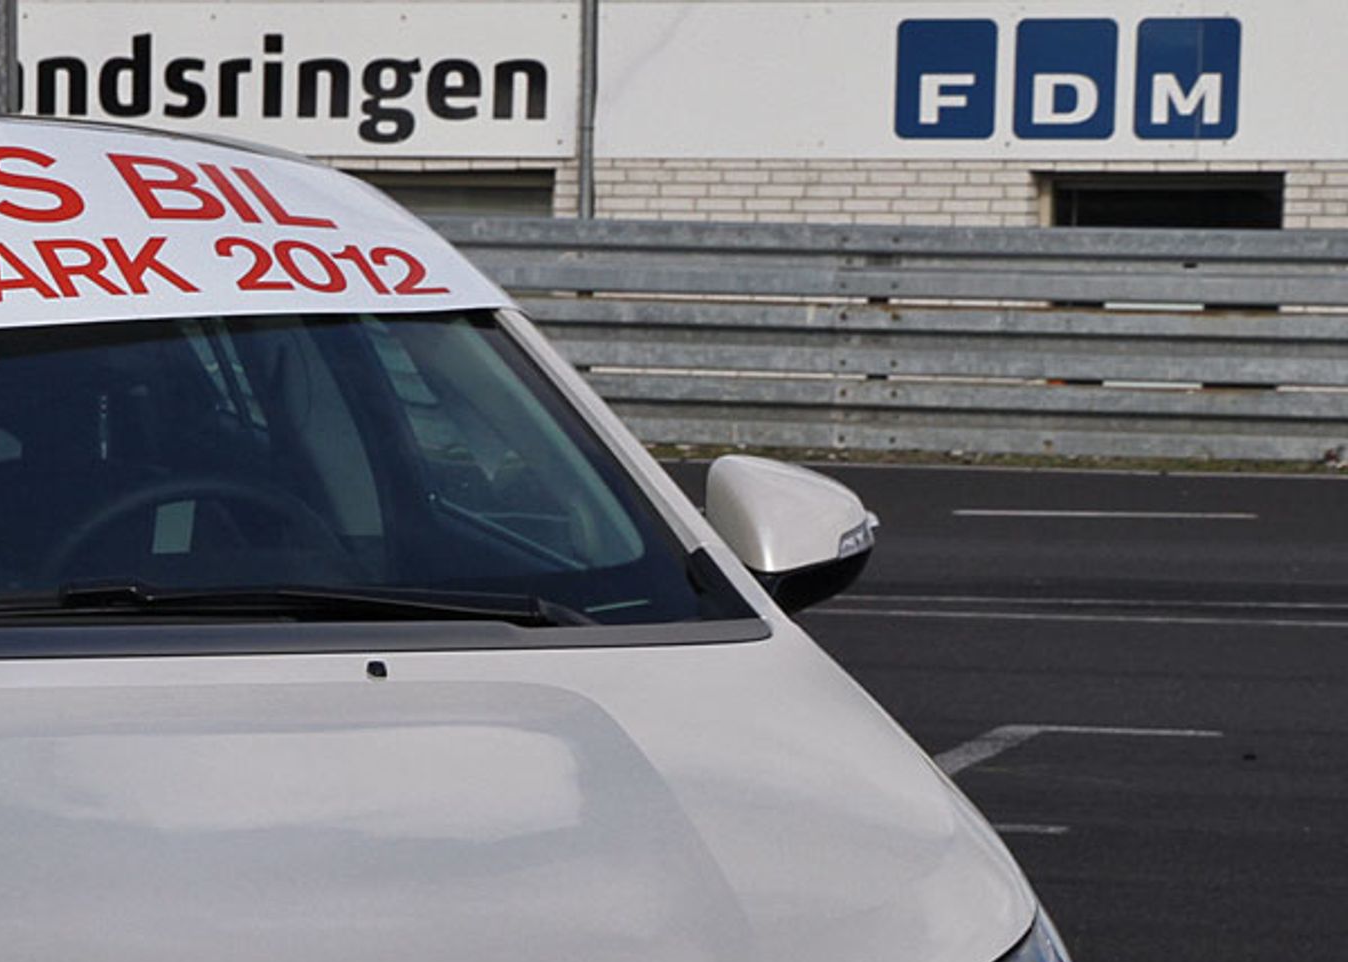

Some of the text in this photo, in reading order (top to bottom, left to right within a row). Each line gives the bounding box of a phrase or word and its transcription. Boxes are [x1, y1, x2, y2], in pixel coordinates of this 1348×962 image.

[918, 72, 1223, 125] FDM
[107, 152, 336, 229] BIL
[215, 238, 451, 296] 2012
